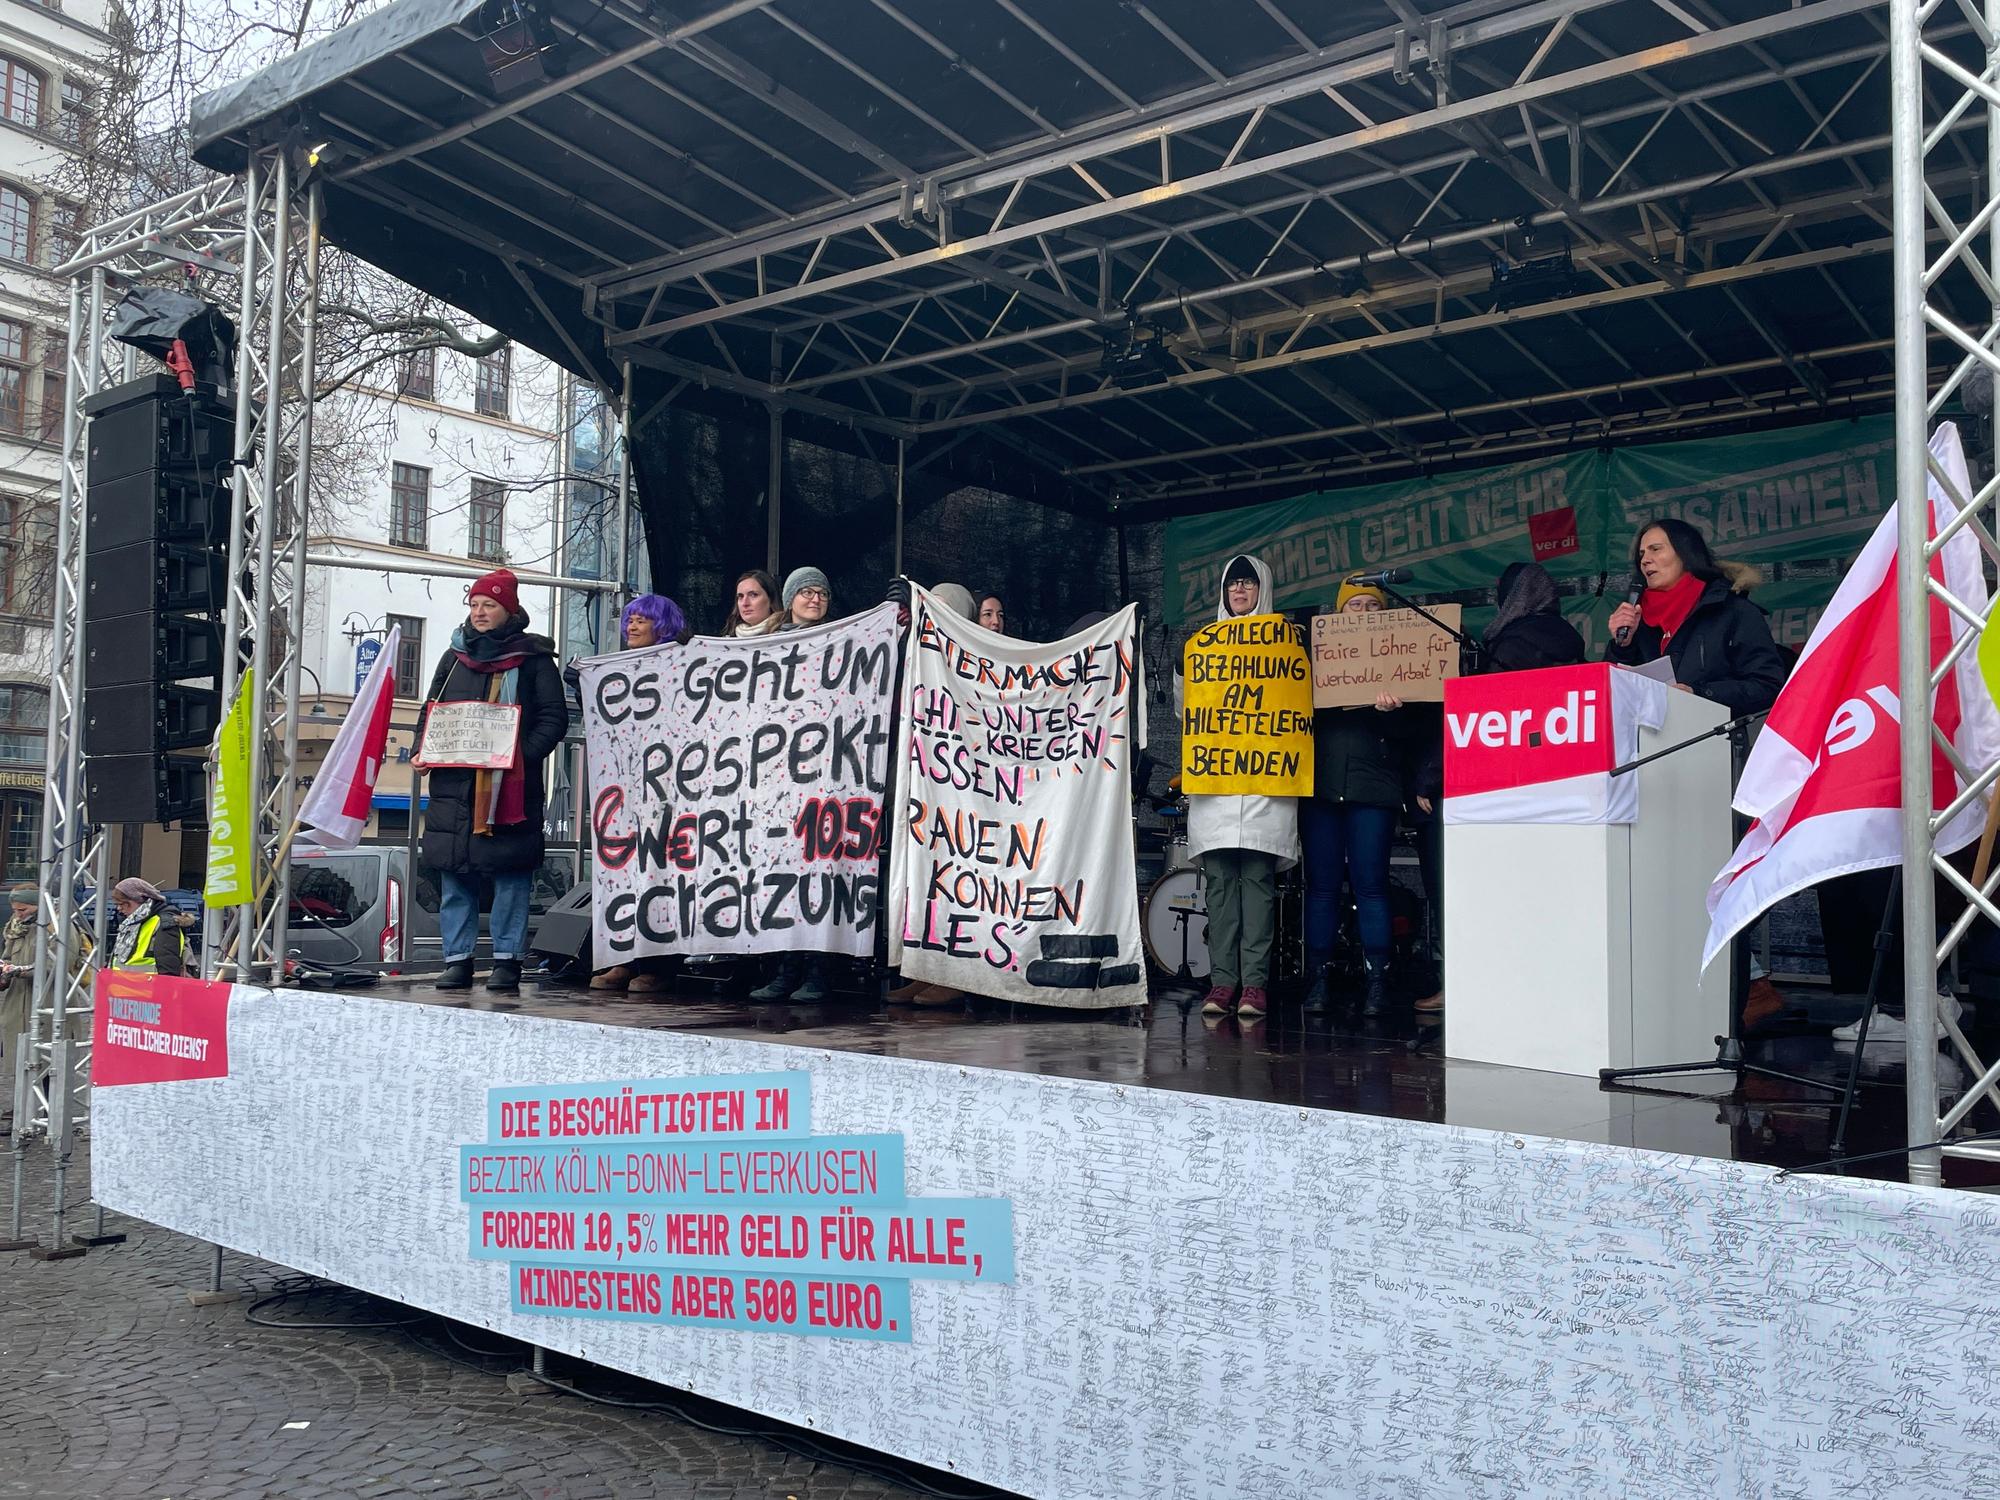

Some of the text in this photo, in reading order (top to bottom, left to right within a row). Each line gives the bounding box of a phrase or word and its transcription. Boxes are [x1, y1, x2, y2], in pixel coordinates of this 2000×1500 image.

[1360, 496, 1453, 564] GEHT
[1465, 467, 1569, 537] MEHR
[1187, 653, 1306, 684] BEZAHLUNG
[1313, 633, 1453, 663] Faire Löhne für
[596, 671, 662, 725] es
[820, 638, 892, 696] UM
[1222, 683, 1264, 711] AM
[463, 720, 484, 730] EUCH
[1184, 706, 1313, 737] HILFETELEFON
[1446, 689, 1597, 749] ver.di
[986, 726, 1104, 761] KRIEGEN
[1186, 745, 1300, 778] BEENDEN
[911, 737, 1023, 807] ASSEN.
[908, 798, 1046, 871] RAUEN
[927, 859, 1084, 926] KÖNNEN
[108, 996, 162, 1026] TARIFRUNDE
[107, 1018, 209, 1062] ÖFFENTLICHER DIENST
[500, 1087, 790, 1139] DIE BESCHÄFTIGTEN IM
[468, 1147, 878, 1195] BEZIRK KÖLN-BONN-LEVERKUSEN
[481, 1205, 984, 1277] FORDERN 10,5% MEHR GELD FÜR ALLE,
[519, 1267, 899, 1332] MINDESTENS ABER 500 EURO.
